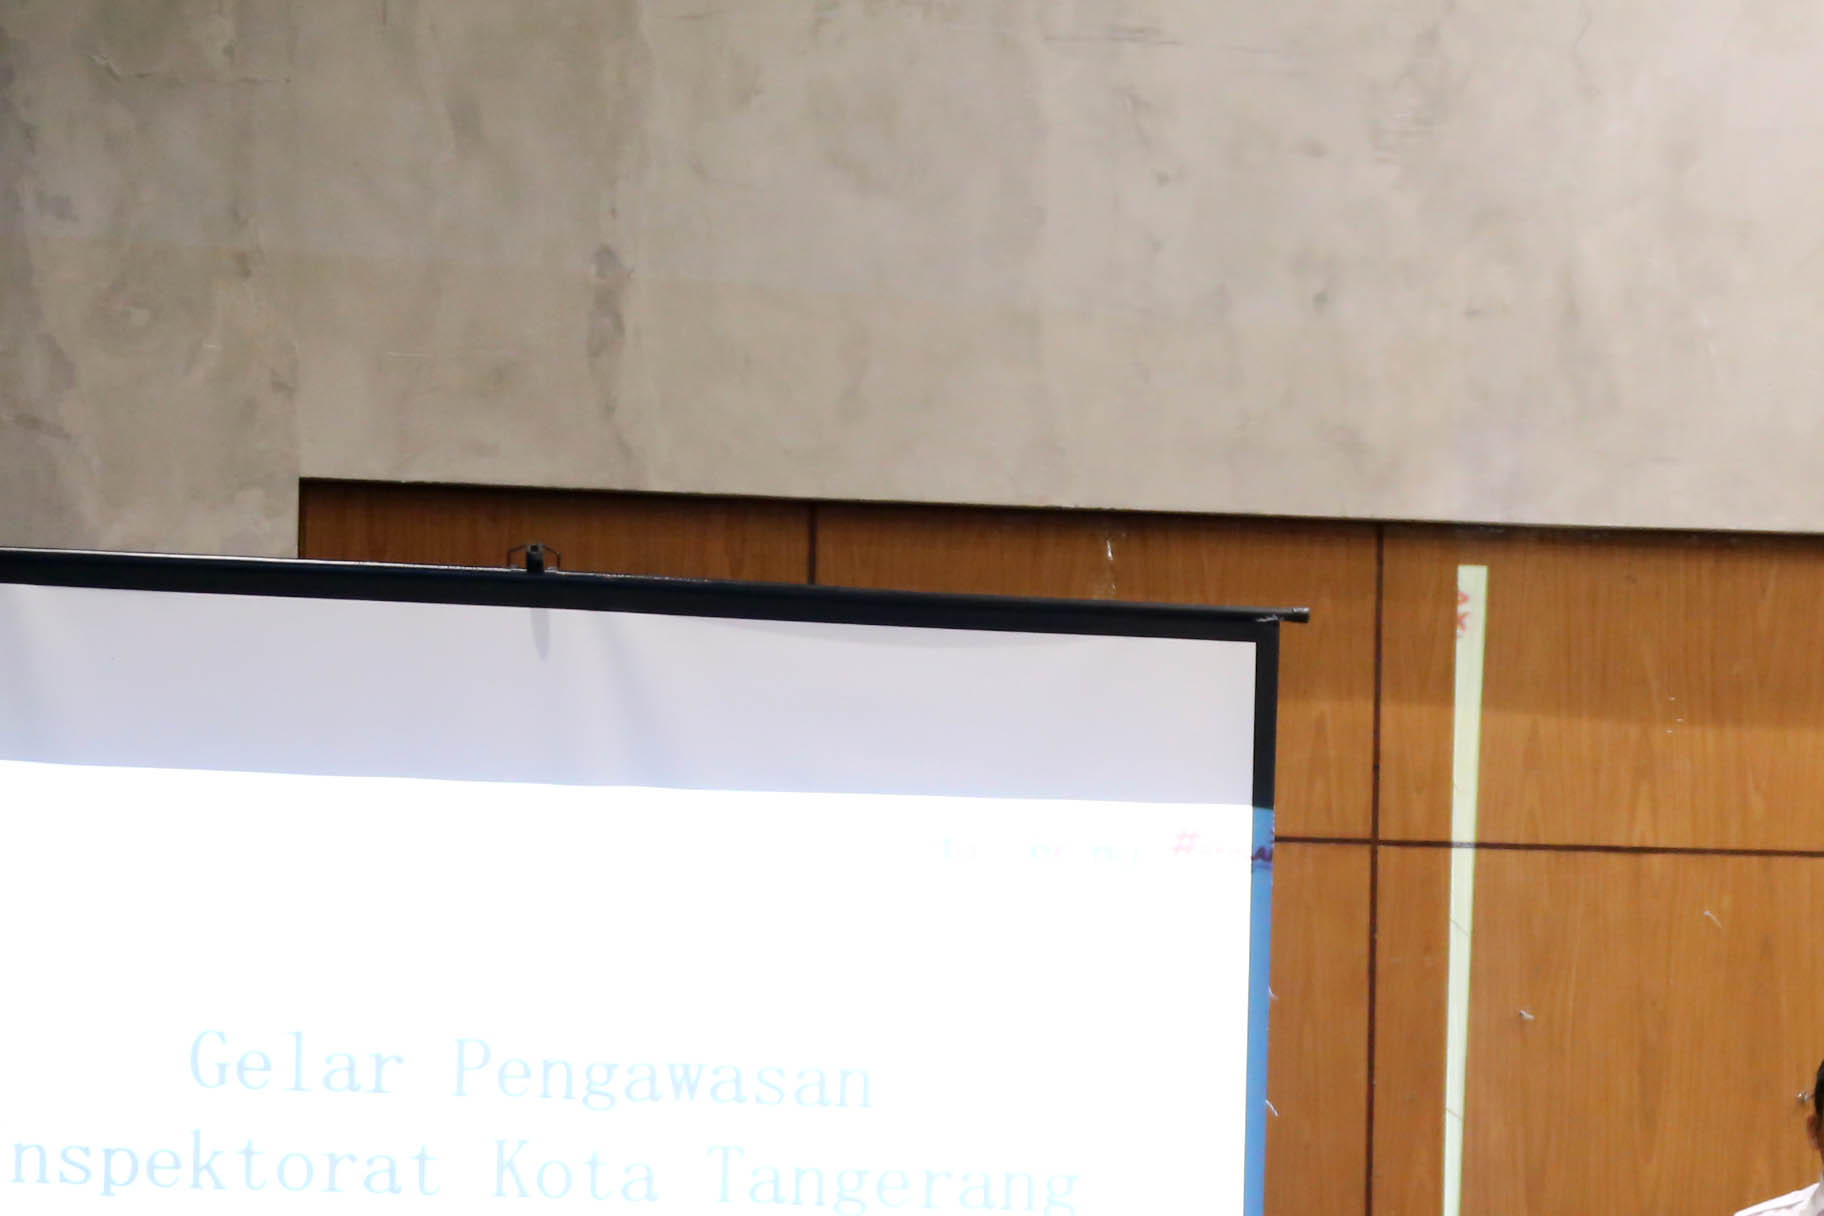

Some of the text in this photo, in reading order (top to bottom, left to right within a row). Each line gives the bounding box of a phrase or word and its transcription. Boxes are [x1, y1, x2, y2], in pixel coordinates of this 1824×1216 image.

[190, 1029, 872, 1112] Gelar Pengawasan
[491, 1138, 659, 1202] Kota
